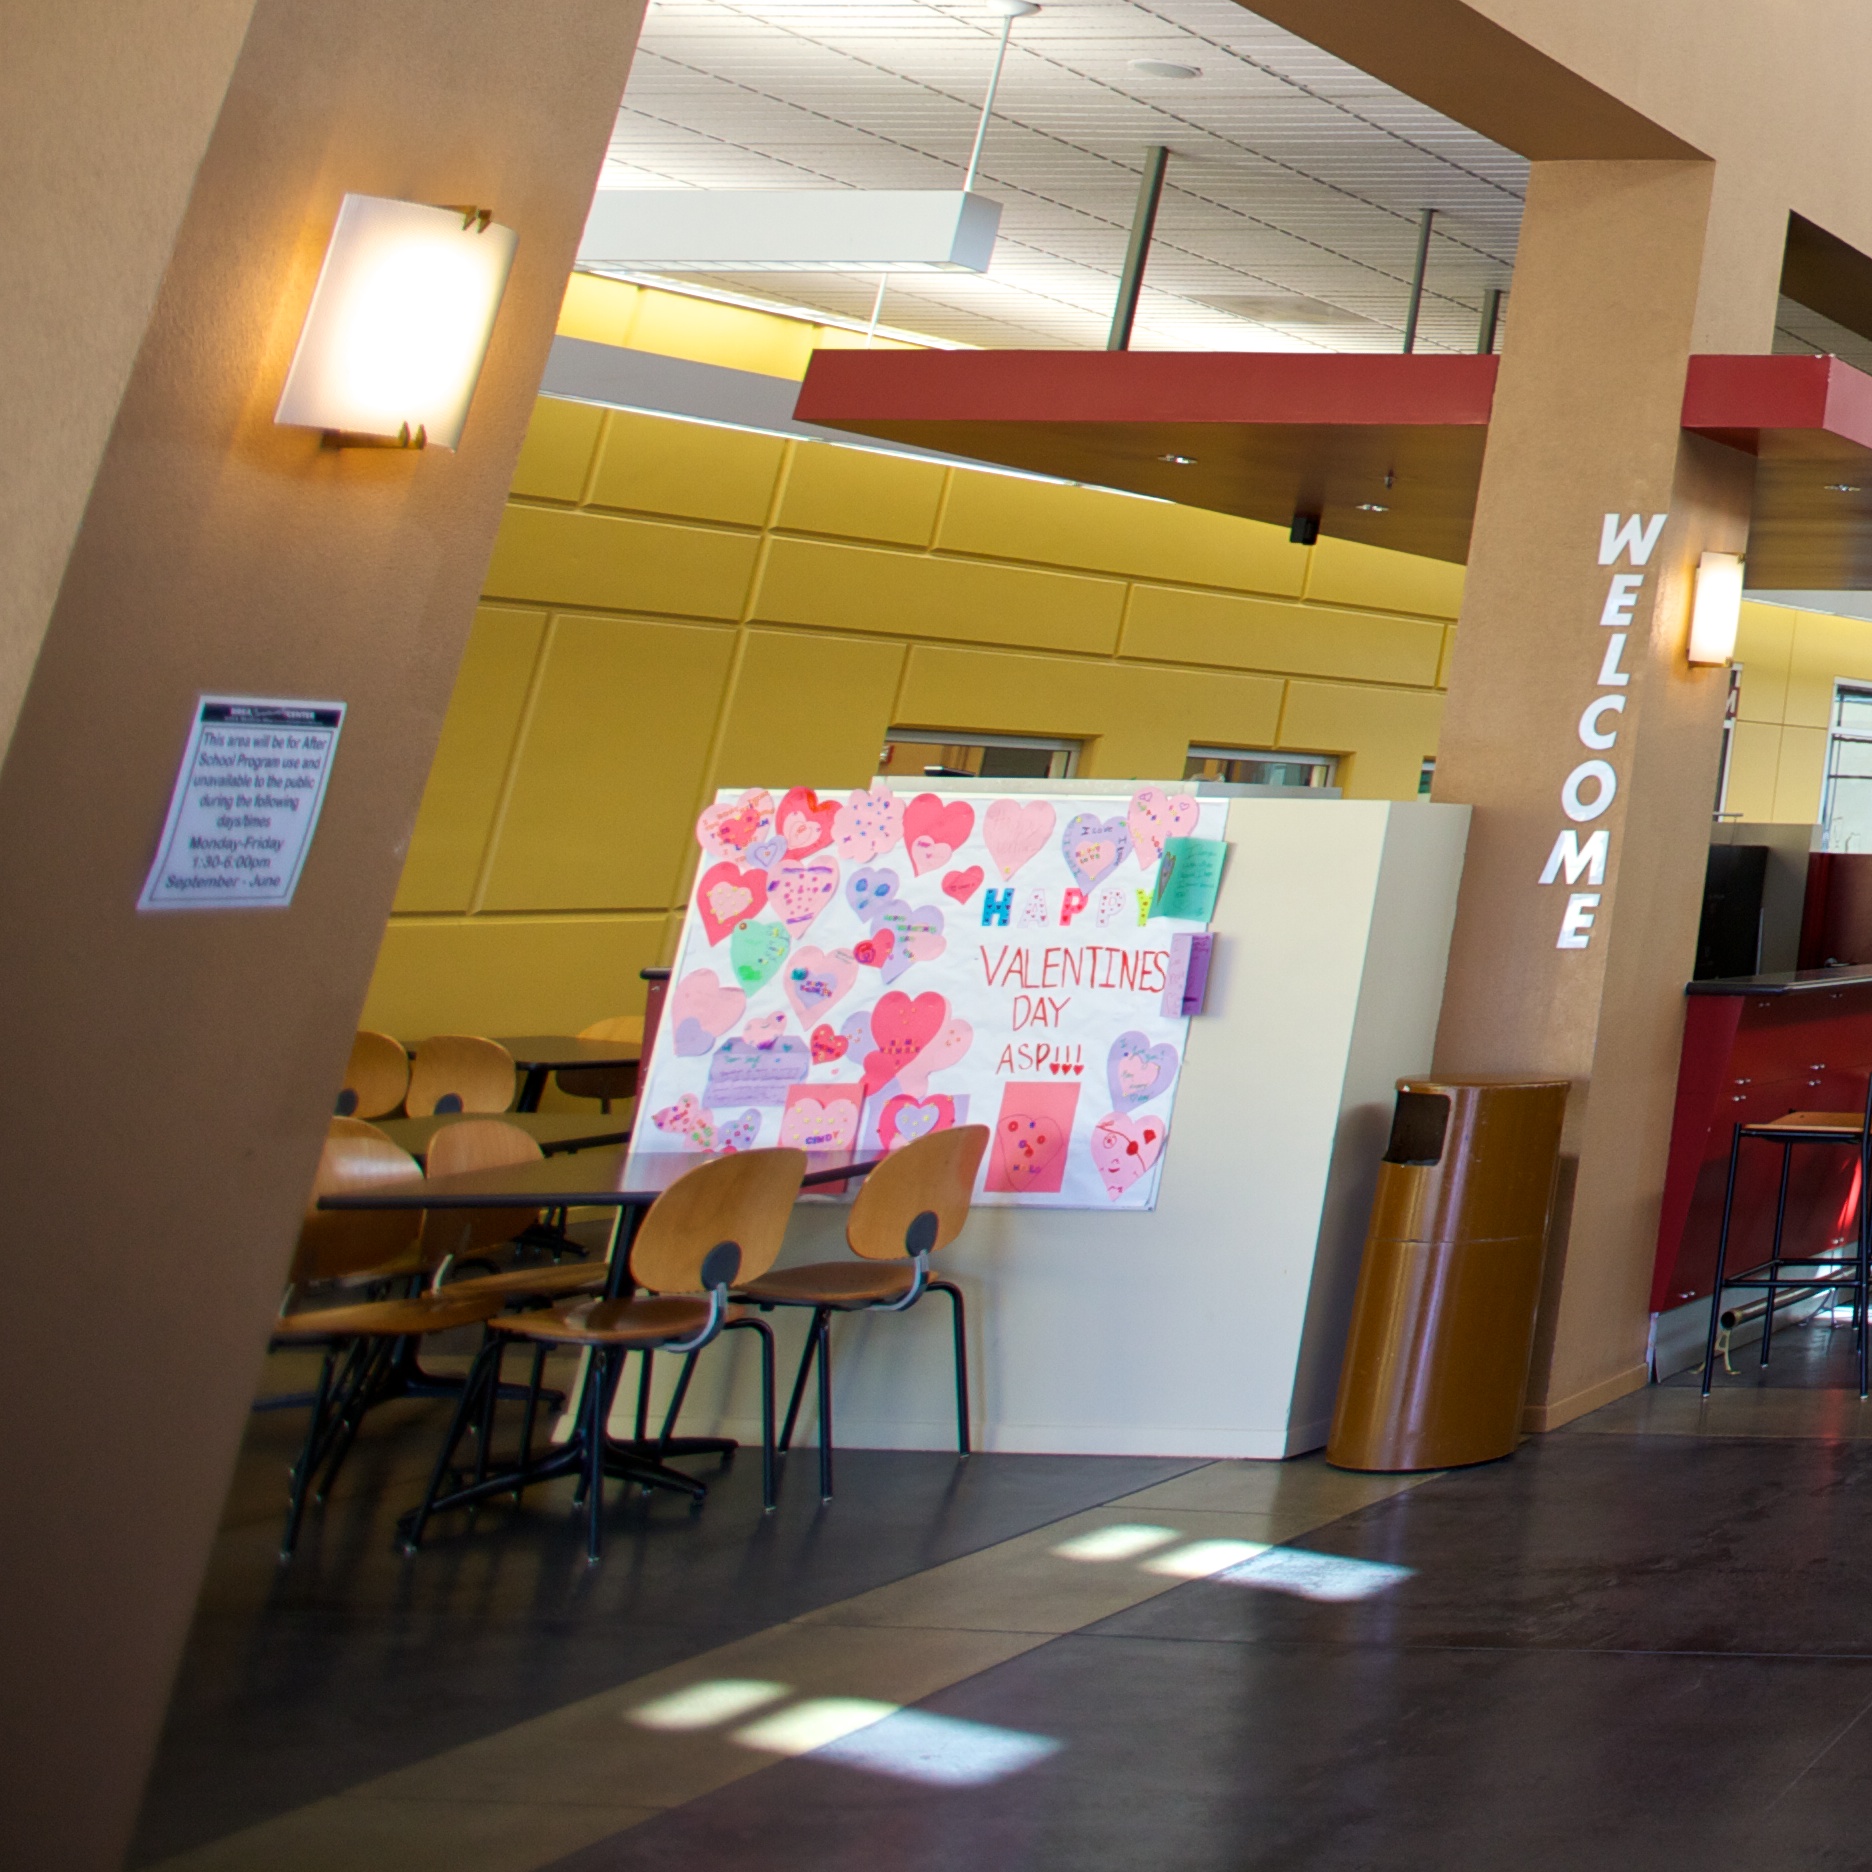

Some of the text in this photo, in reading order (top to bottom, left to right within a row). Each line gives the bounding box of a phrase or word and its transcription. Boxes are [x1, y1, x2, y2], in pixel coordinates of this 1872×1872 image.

[203, 731, 327, 751] This area will be for After
[1538, 514, 1668, 948] WELCOME
[199, 753, 321, 770] School Program use and
[251, 775, 264, 788] to
[266, 775, 283, 789] the
[284, 776, 315, 791] public
[199, 794, 299, 812] during the following
[981, 887, 1154, 928] HAPPY
[979, 944, 1170, 994] VALENTINES
[1013, 995, 1071, 1031] DAY
[996, 1043, 1084, 1075] ASP!!!
[805, 1130, 839, 1145] CINDY
